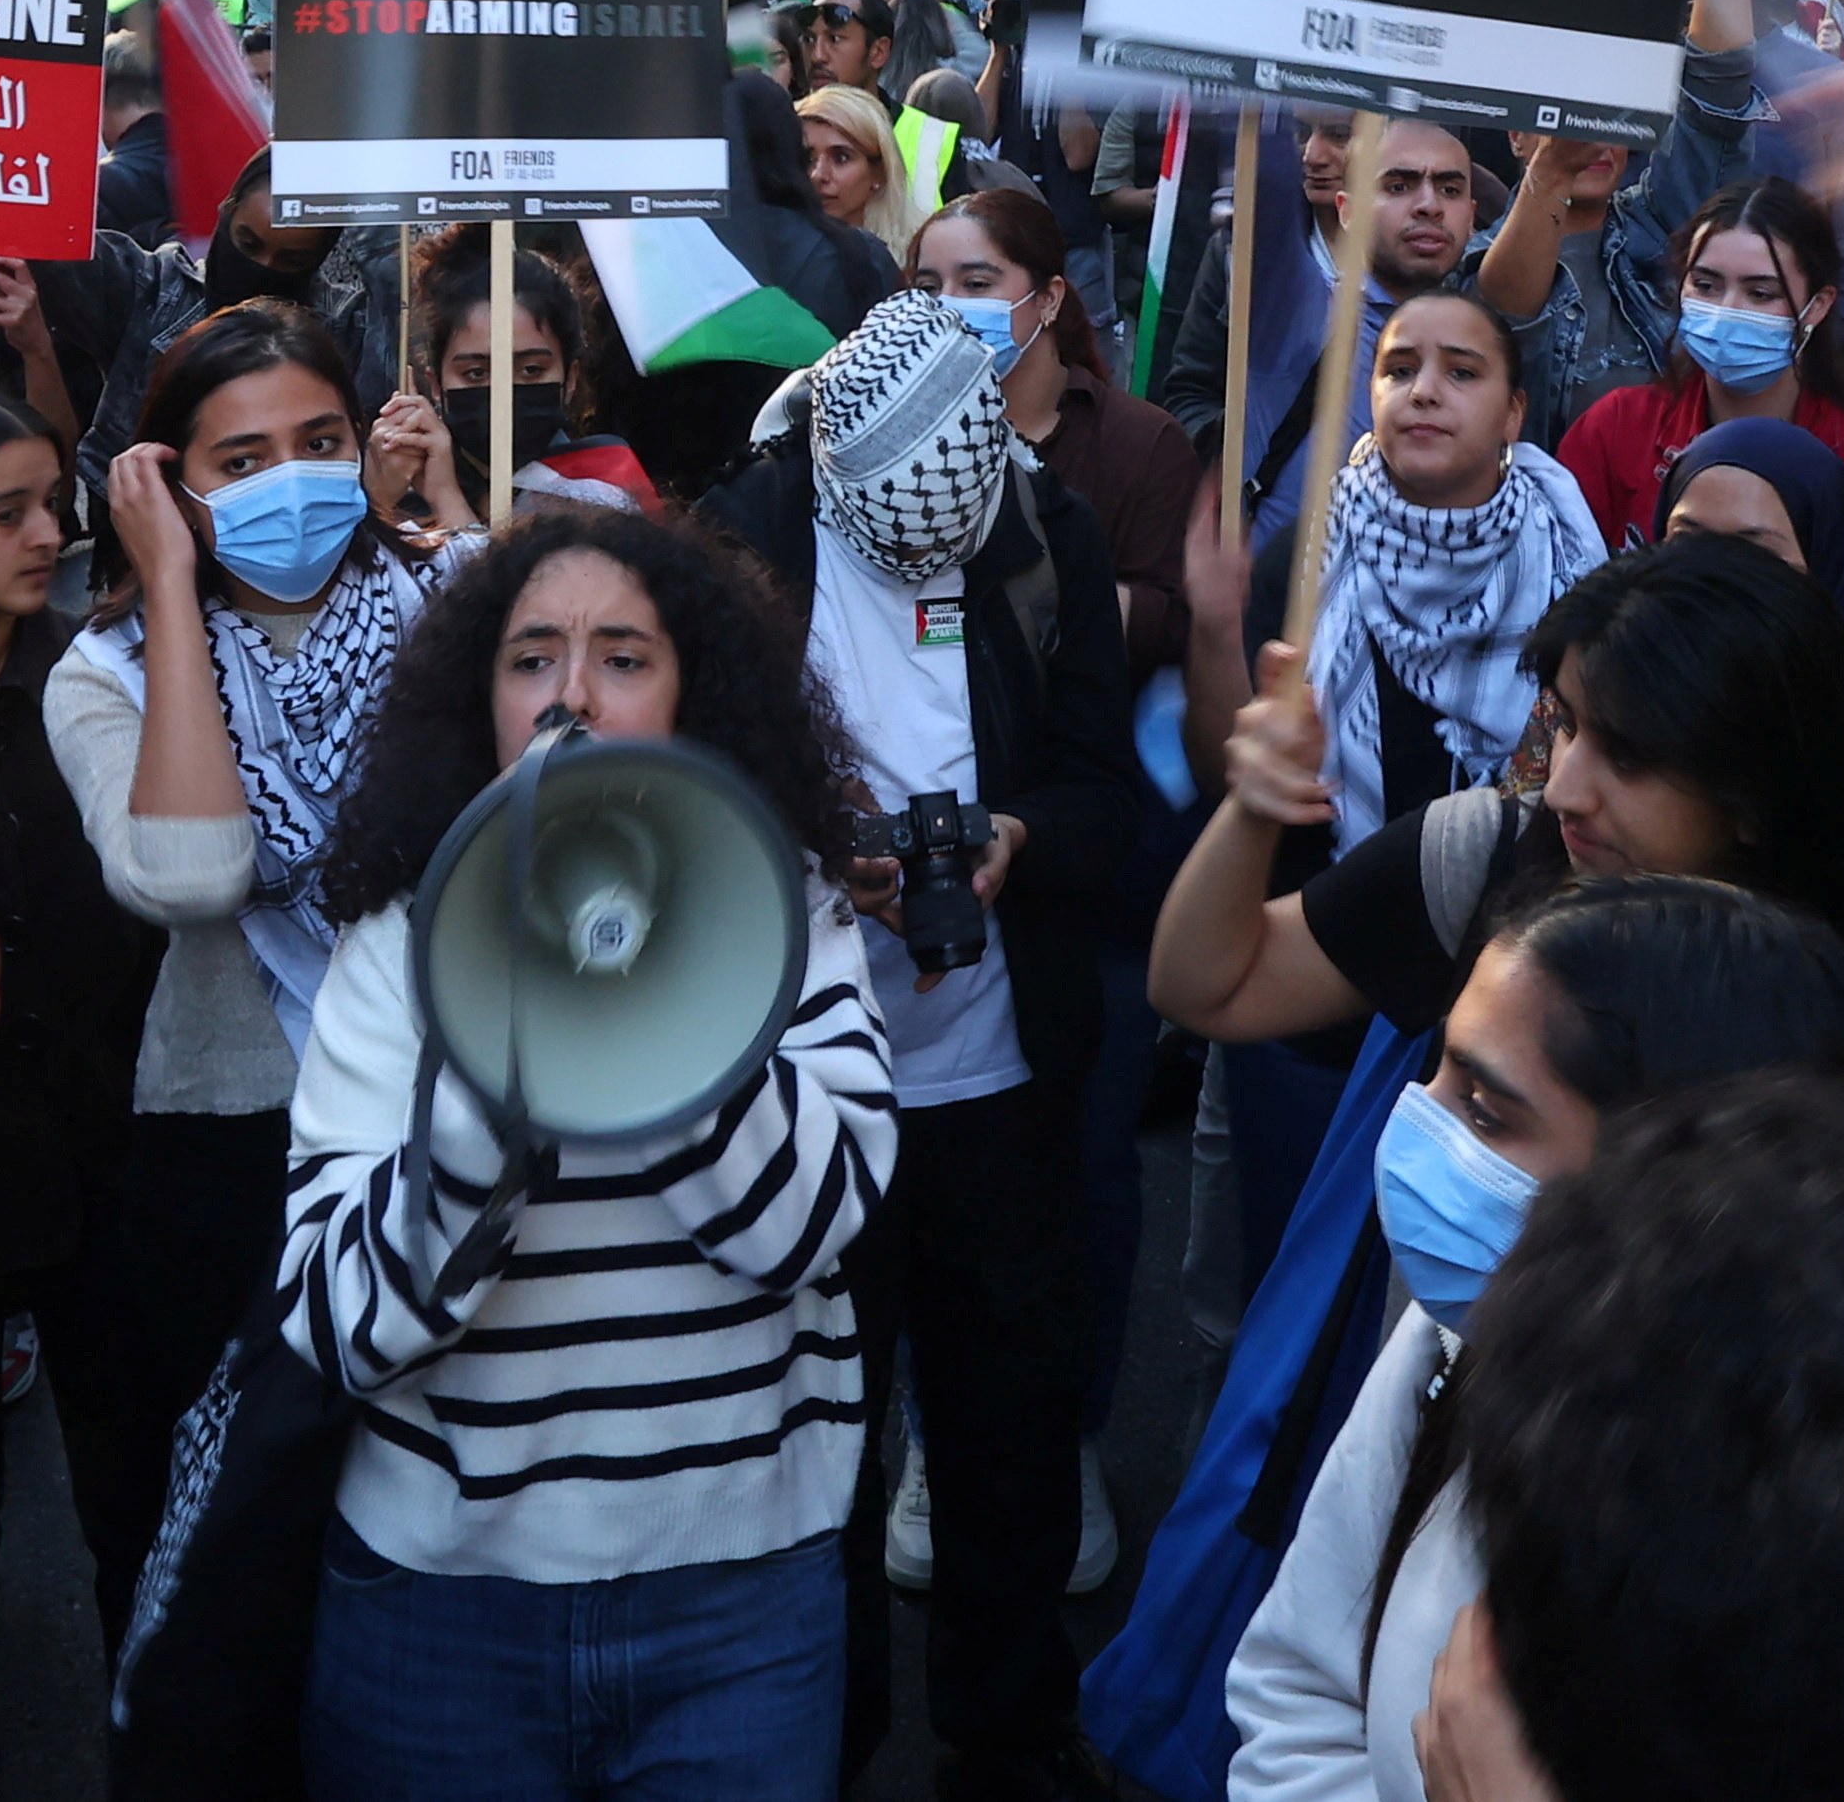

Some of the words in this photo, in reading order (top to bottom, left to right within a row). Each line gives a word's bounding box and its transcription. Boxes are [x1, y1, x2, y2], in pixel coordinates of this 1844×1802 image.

[504, 149, 555, 166] FRIENDS
[450, 150, 494, 181] FOA
[927, 603, 959, 614] BOYCOTT
[929, 615, 957, 626] ISRAELI
